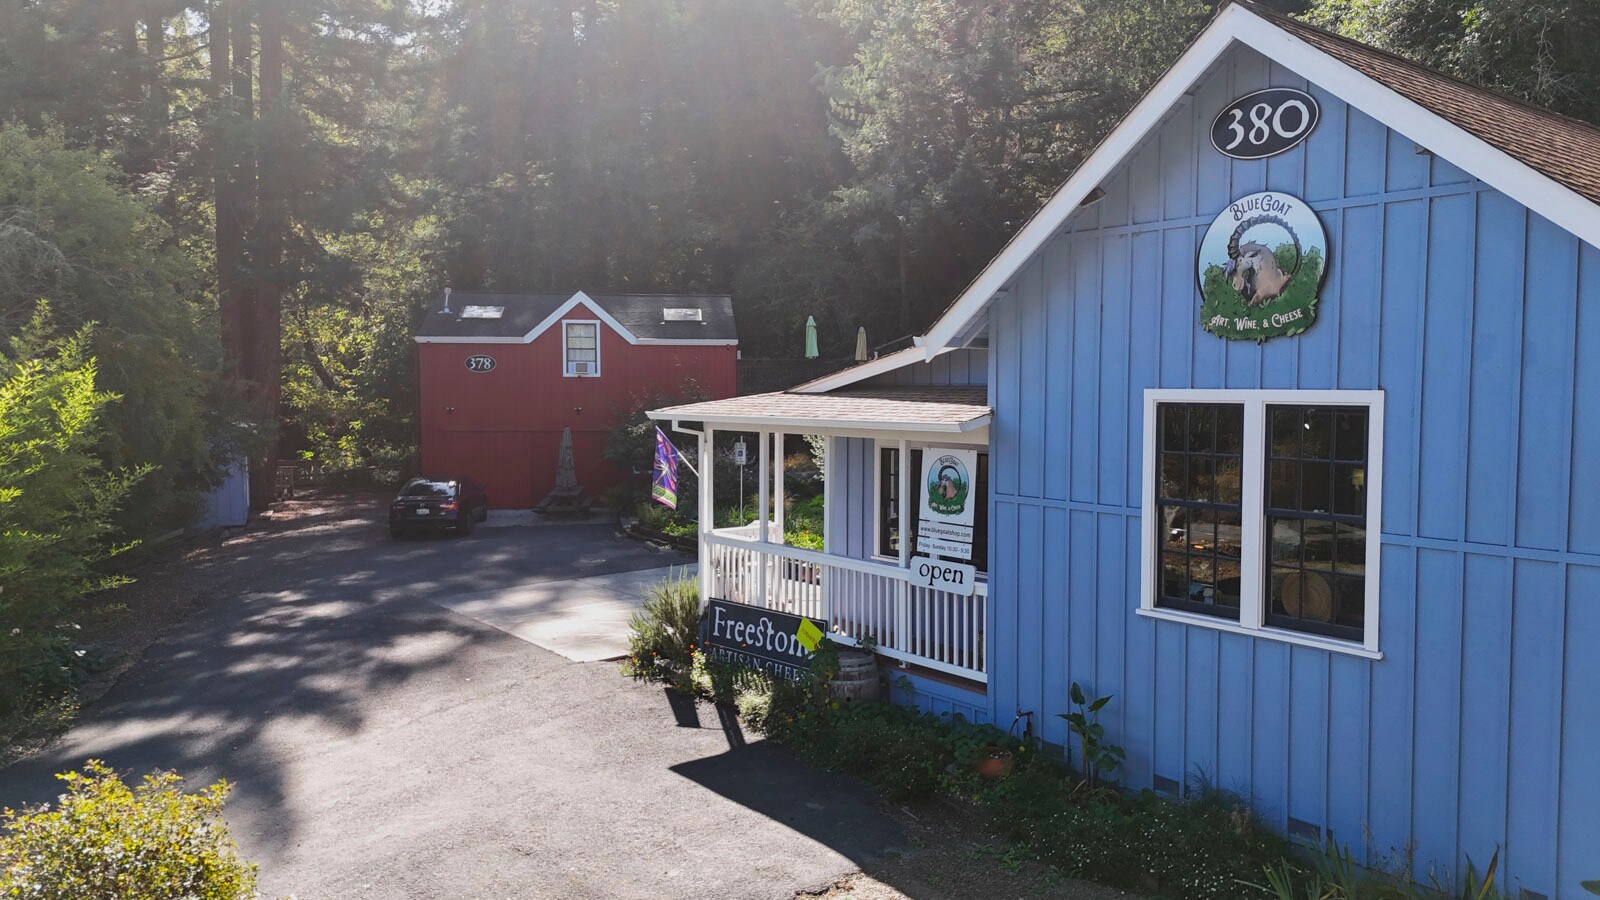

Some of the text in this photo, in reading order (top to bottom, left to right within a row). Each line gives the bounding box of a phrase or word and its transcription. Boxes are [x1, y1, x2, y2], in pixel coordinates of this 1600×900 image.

[1226, 99, 1310, 150] 380
[1262, 319, 1269, 328] &
[1271, 308, 1303, 328] CHEESE
[470, 357, 491, 370] 378
[920, 525, 971, 538] www.bluegoatshop.com
[918, 541, 930, 549] Friday
[932, 543, 946, 551] Sunday
[919, 563, 964, 587] open
[713, 606, 816, 660] Freeston
